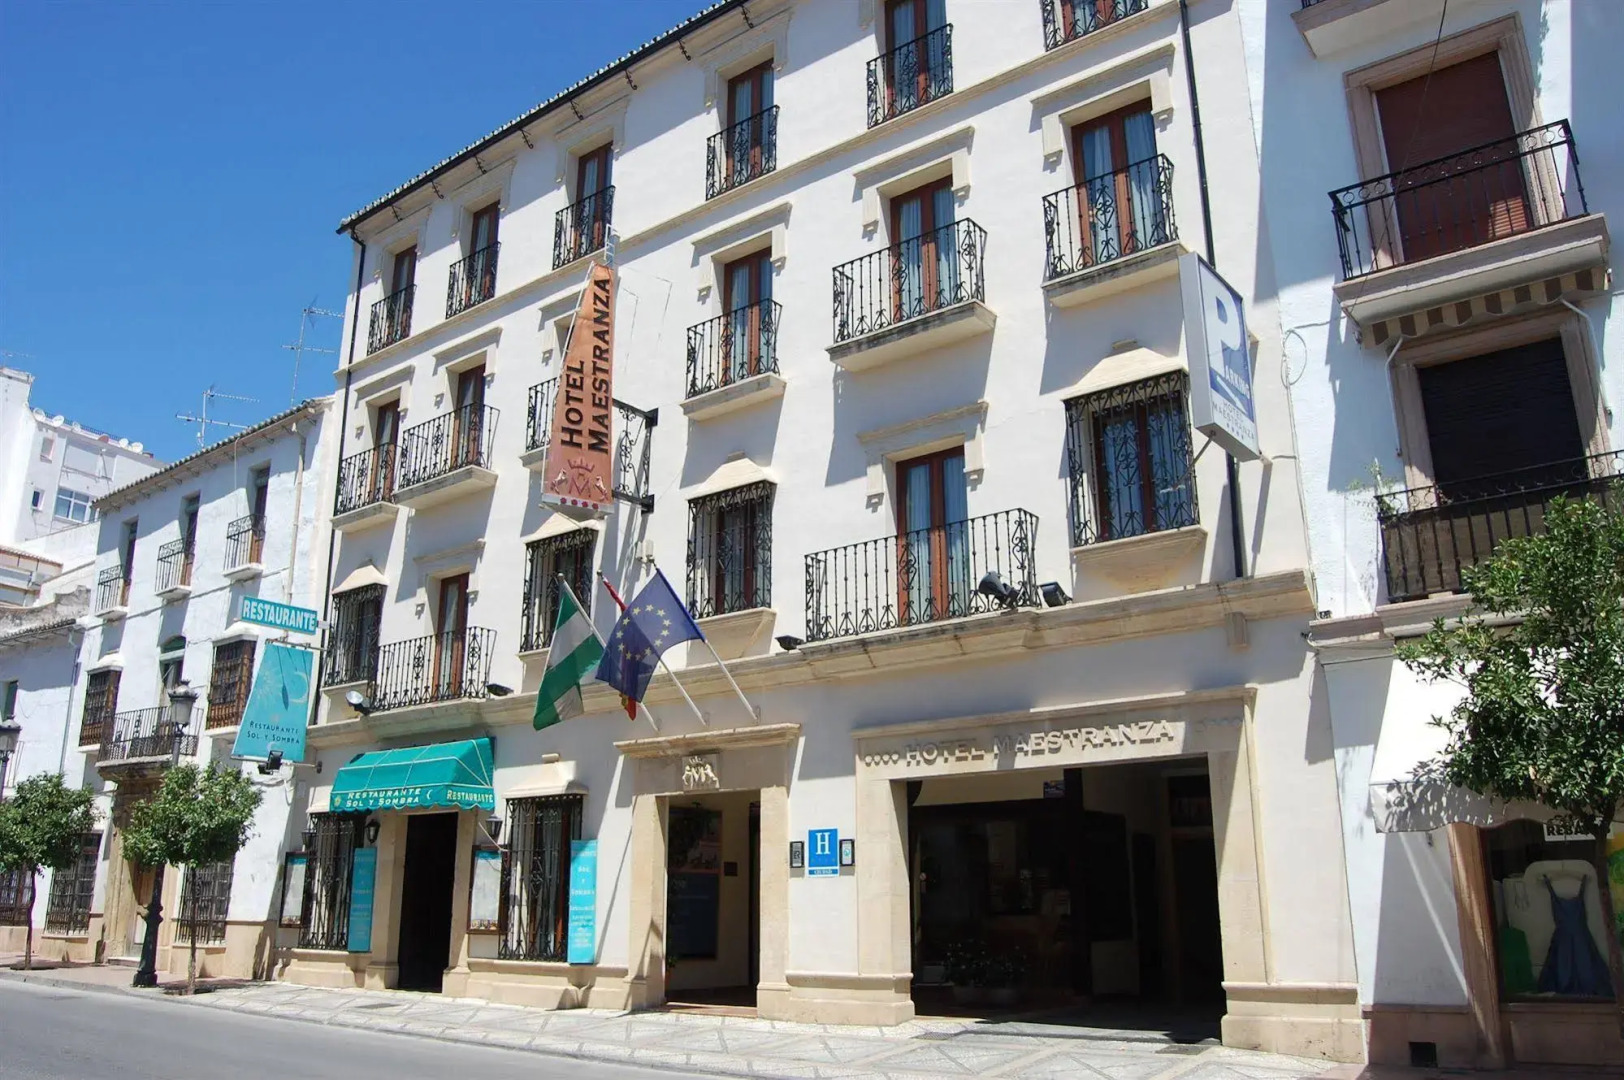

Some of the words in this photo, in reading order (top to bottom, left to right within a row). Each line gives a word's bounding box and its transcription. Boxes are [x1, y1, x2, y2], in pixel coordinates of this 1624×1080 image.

[588, 278, 612, 454] MAESTRANZA
[561, 360, 585, 449] HOTEL
[1223, 400, 1244, 420] HOTEL
[1212, 403, 1255, 440] MAESTRANZA
[243, 600, 316, 631] RESTAURANTE
[247, 730, 260, 740] SOL
[272, 733, 300, 744] SOMBRA
[250, 720, 299, 735] RESTAURANTE
[906, 740, 986, 765] HOTEL
[994, 720, 1174, 757] MAESTRANZA
[346, 799, 363, 808] SOL
[378, 796, 420, 806] SOMBRA
[347, 788, 422, 800] RESTAURANTE
[446, 790, 494, 803] RESTAURANTE
[815, 832, 831, 855] H
